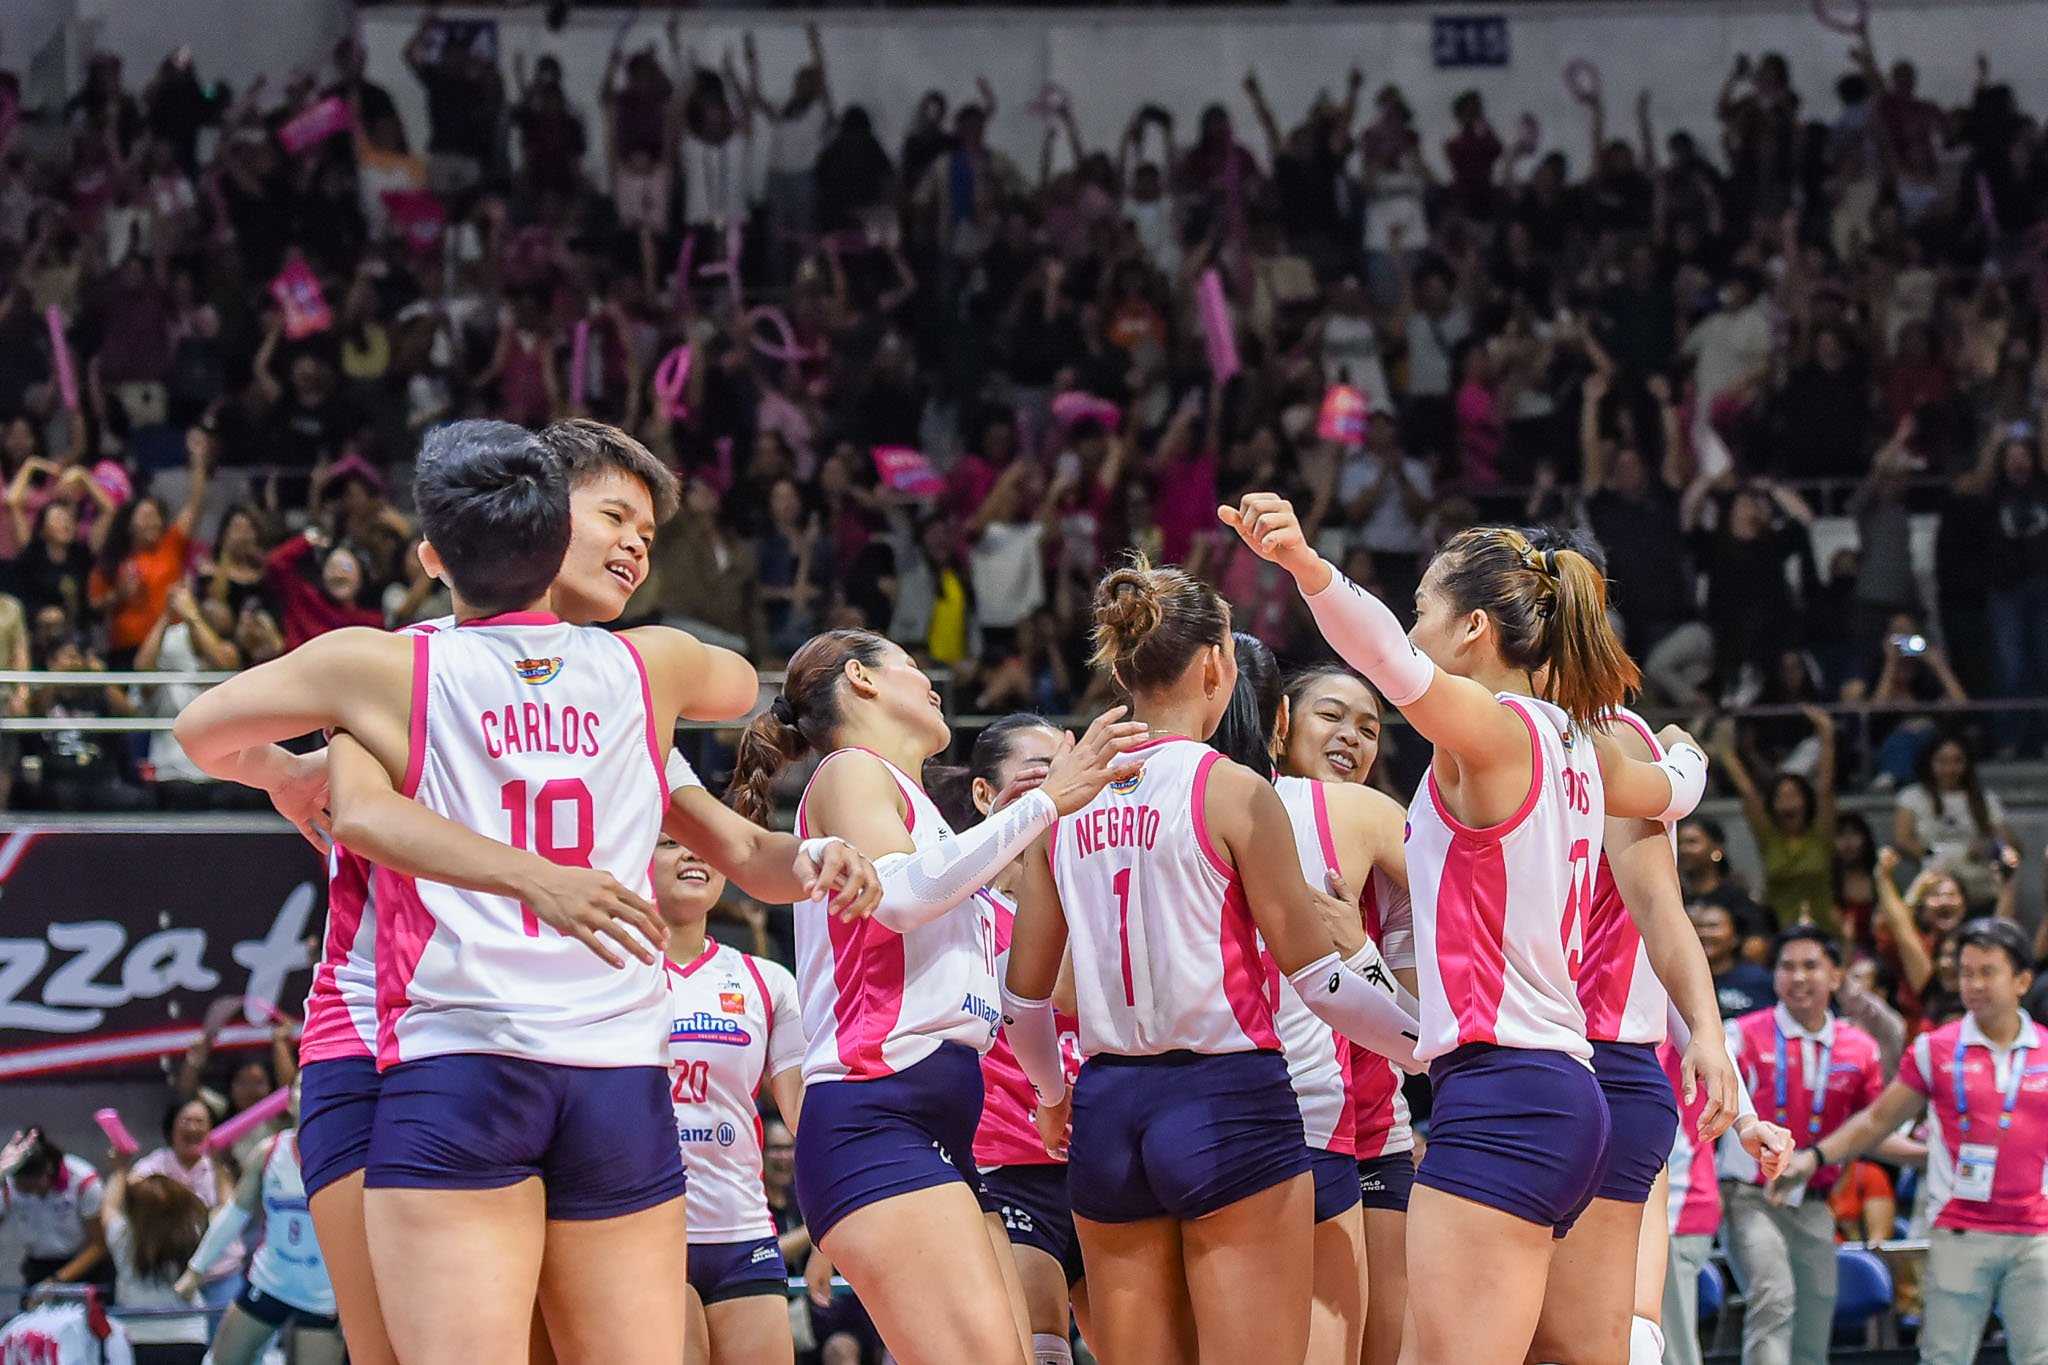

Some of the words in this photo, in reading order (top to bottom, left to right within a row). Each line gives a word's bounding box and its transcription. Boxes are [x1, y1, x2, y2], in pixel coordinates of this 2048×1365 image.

[481, 702, 600, 759] CARLOS
[1113, 868, 1135, 1007] 1
[673, 1059, 709, 1103] 20
